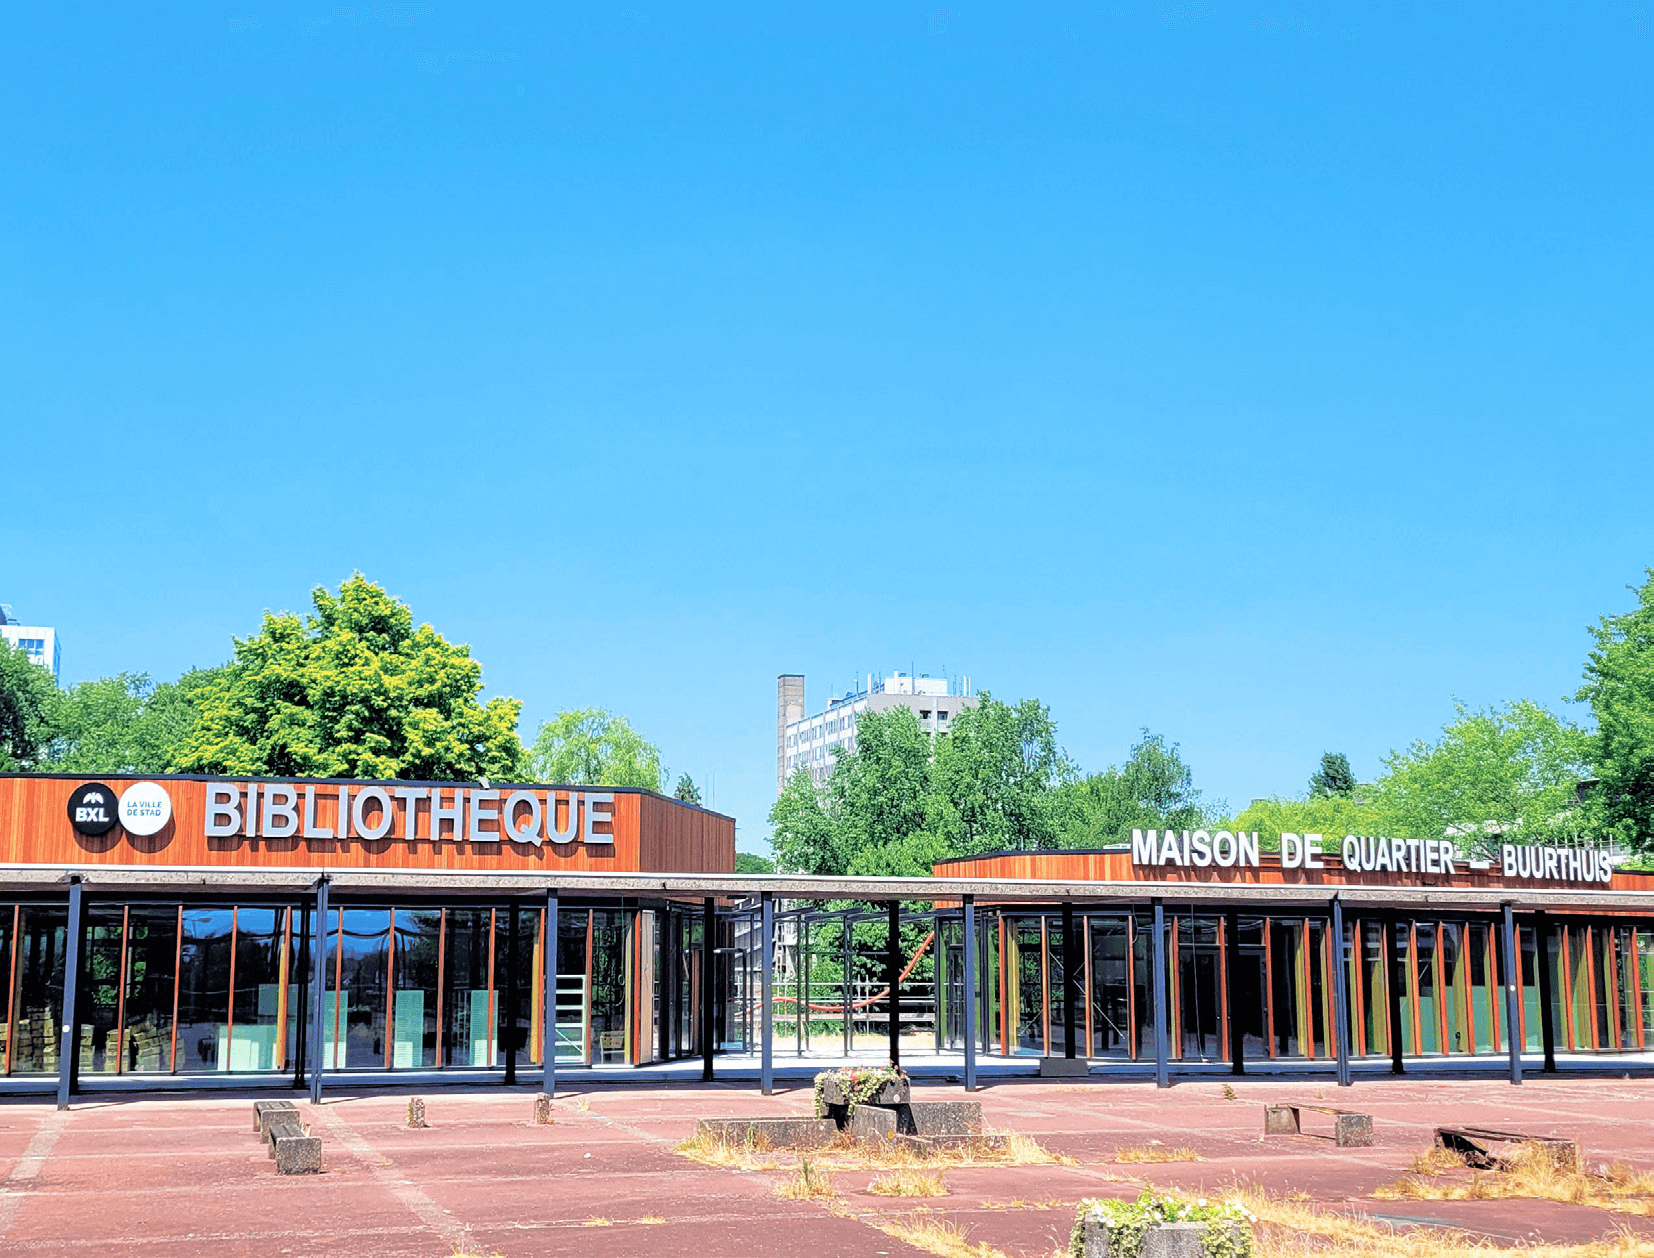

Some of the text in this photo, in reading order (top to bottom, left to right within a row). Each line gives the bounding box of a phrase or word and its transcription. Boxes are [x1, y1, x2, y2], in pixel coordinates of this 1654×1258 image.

[75, 807, 109, 823] BXL
[127, 809, 161, 817] DE STAD
[204, 779, 614, 847] BIBLIOTHÈQUE
[1131, 828, 1260, 867] MAISON
[1281, 832, 1324, 869] DE
[1342, 835, 1456, 875] QUARTIER
[1502, 844, 1612, 883] BUURTHUIS
